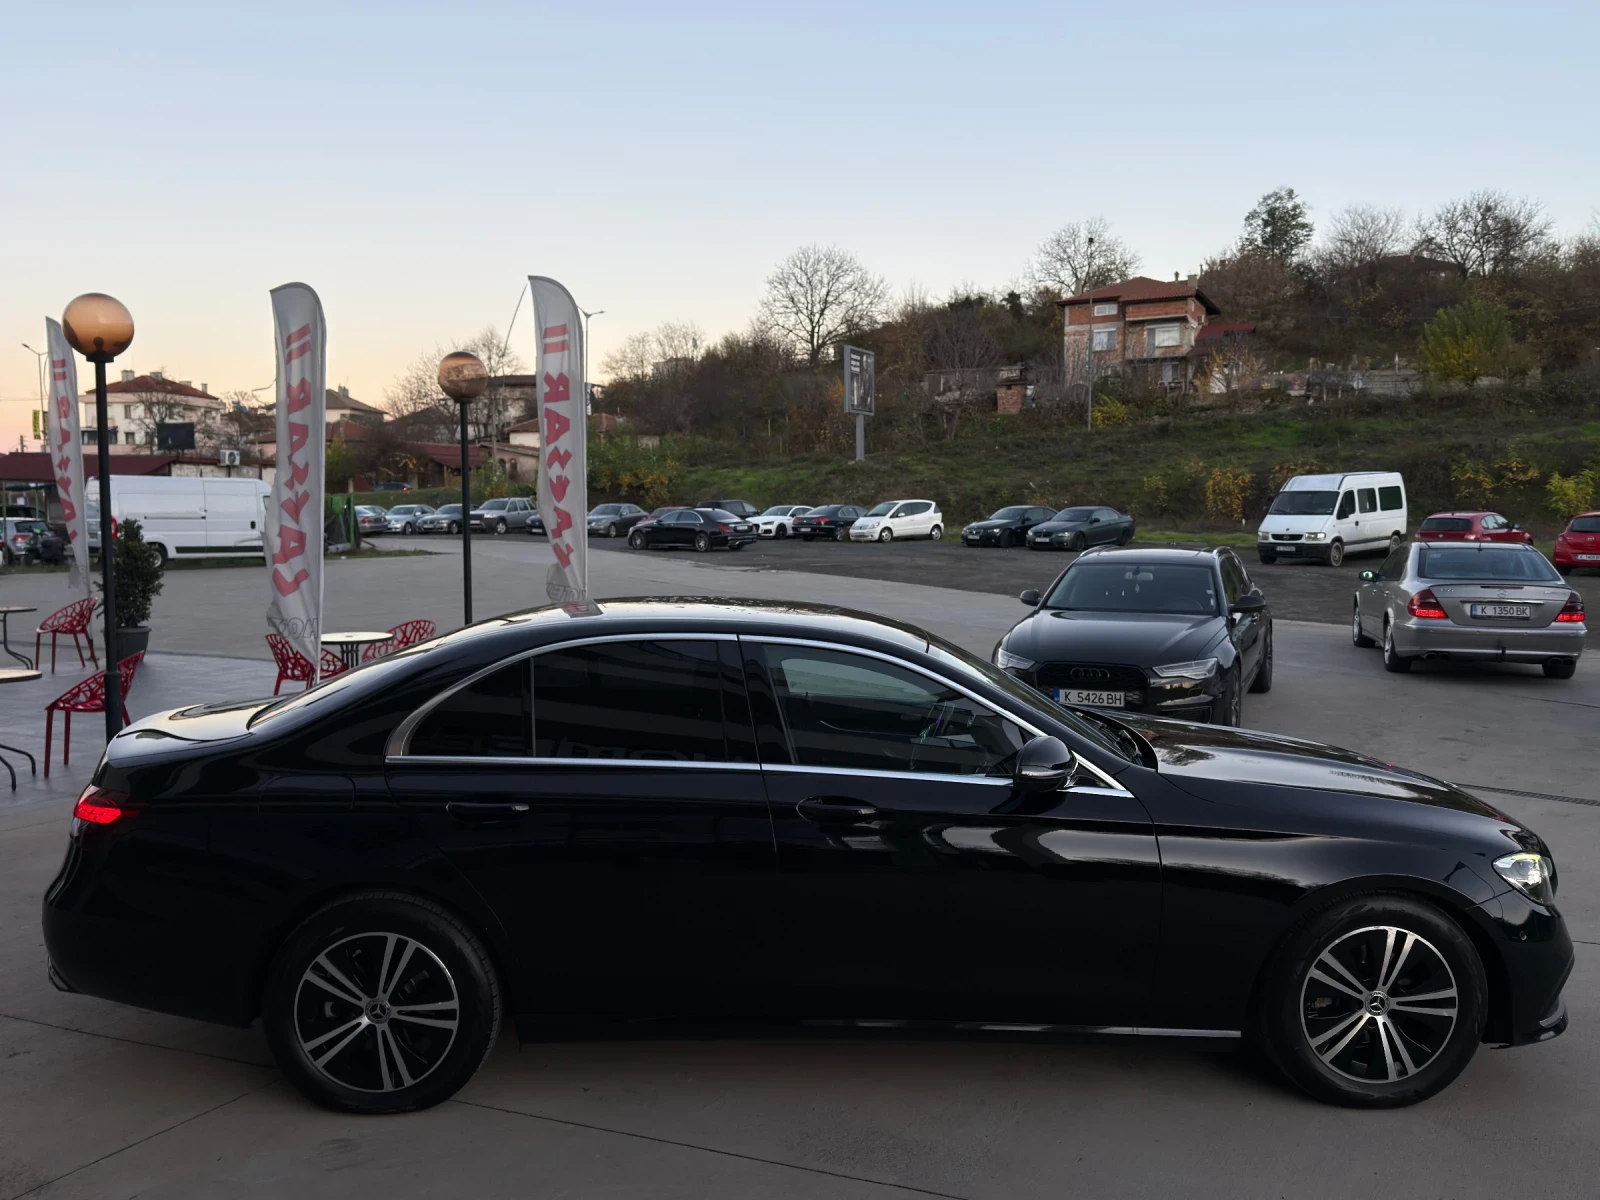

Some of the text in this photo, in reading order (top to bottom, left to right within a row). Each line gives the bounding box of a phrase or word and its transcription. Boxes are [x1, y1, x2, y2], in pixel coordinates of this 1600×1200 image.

[1480, 605, 1529, 616] K 1350 BK
[1064, 691, 1123, 705] K 5426 BH
